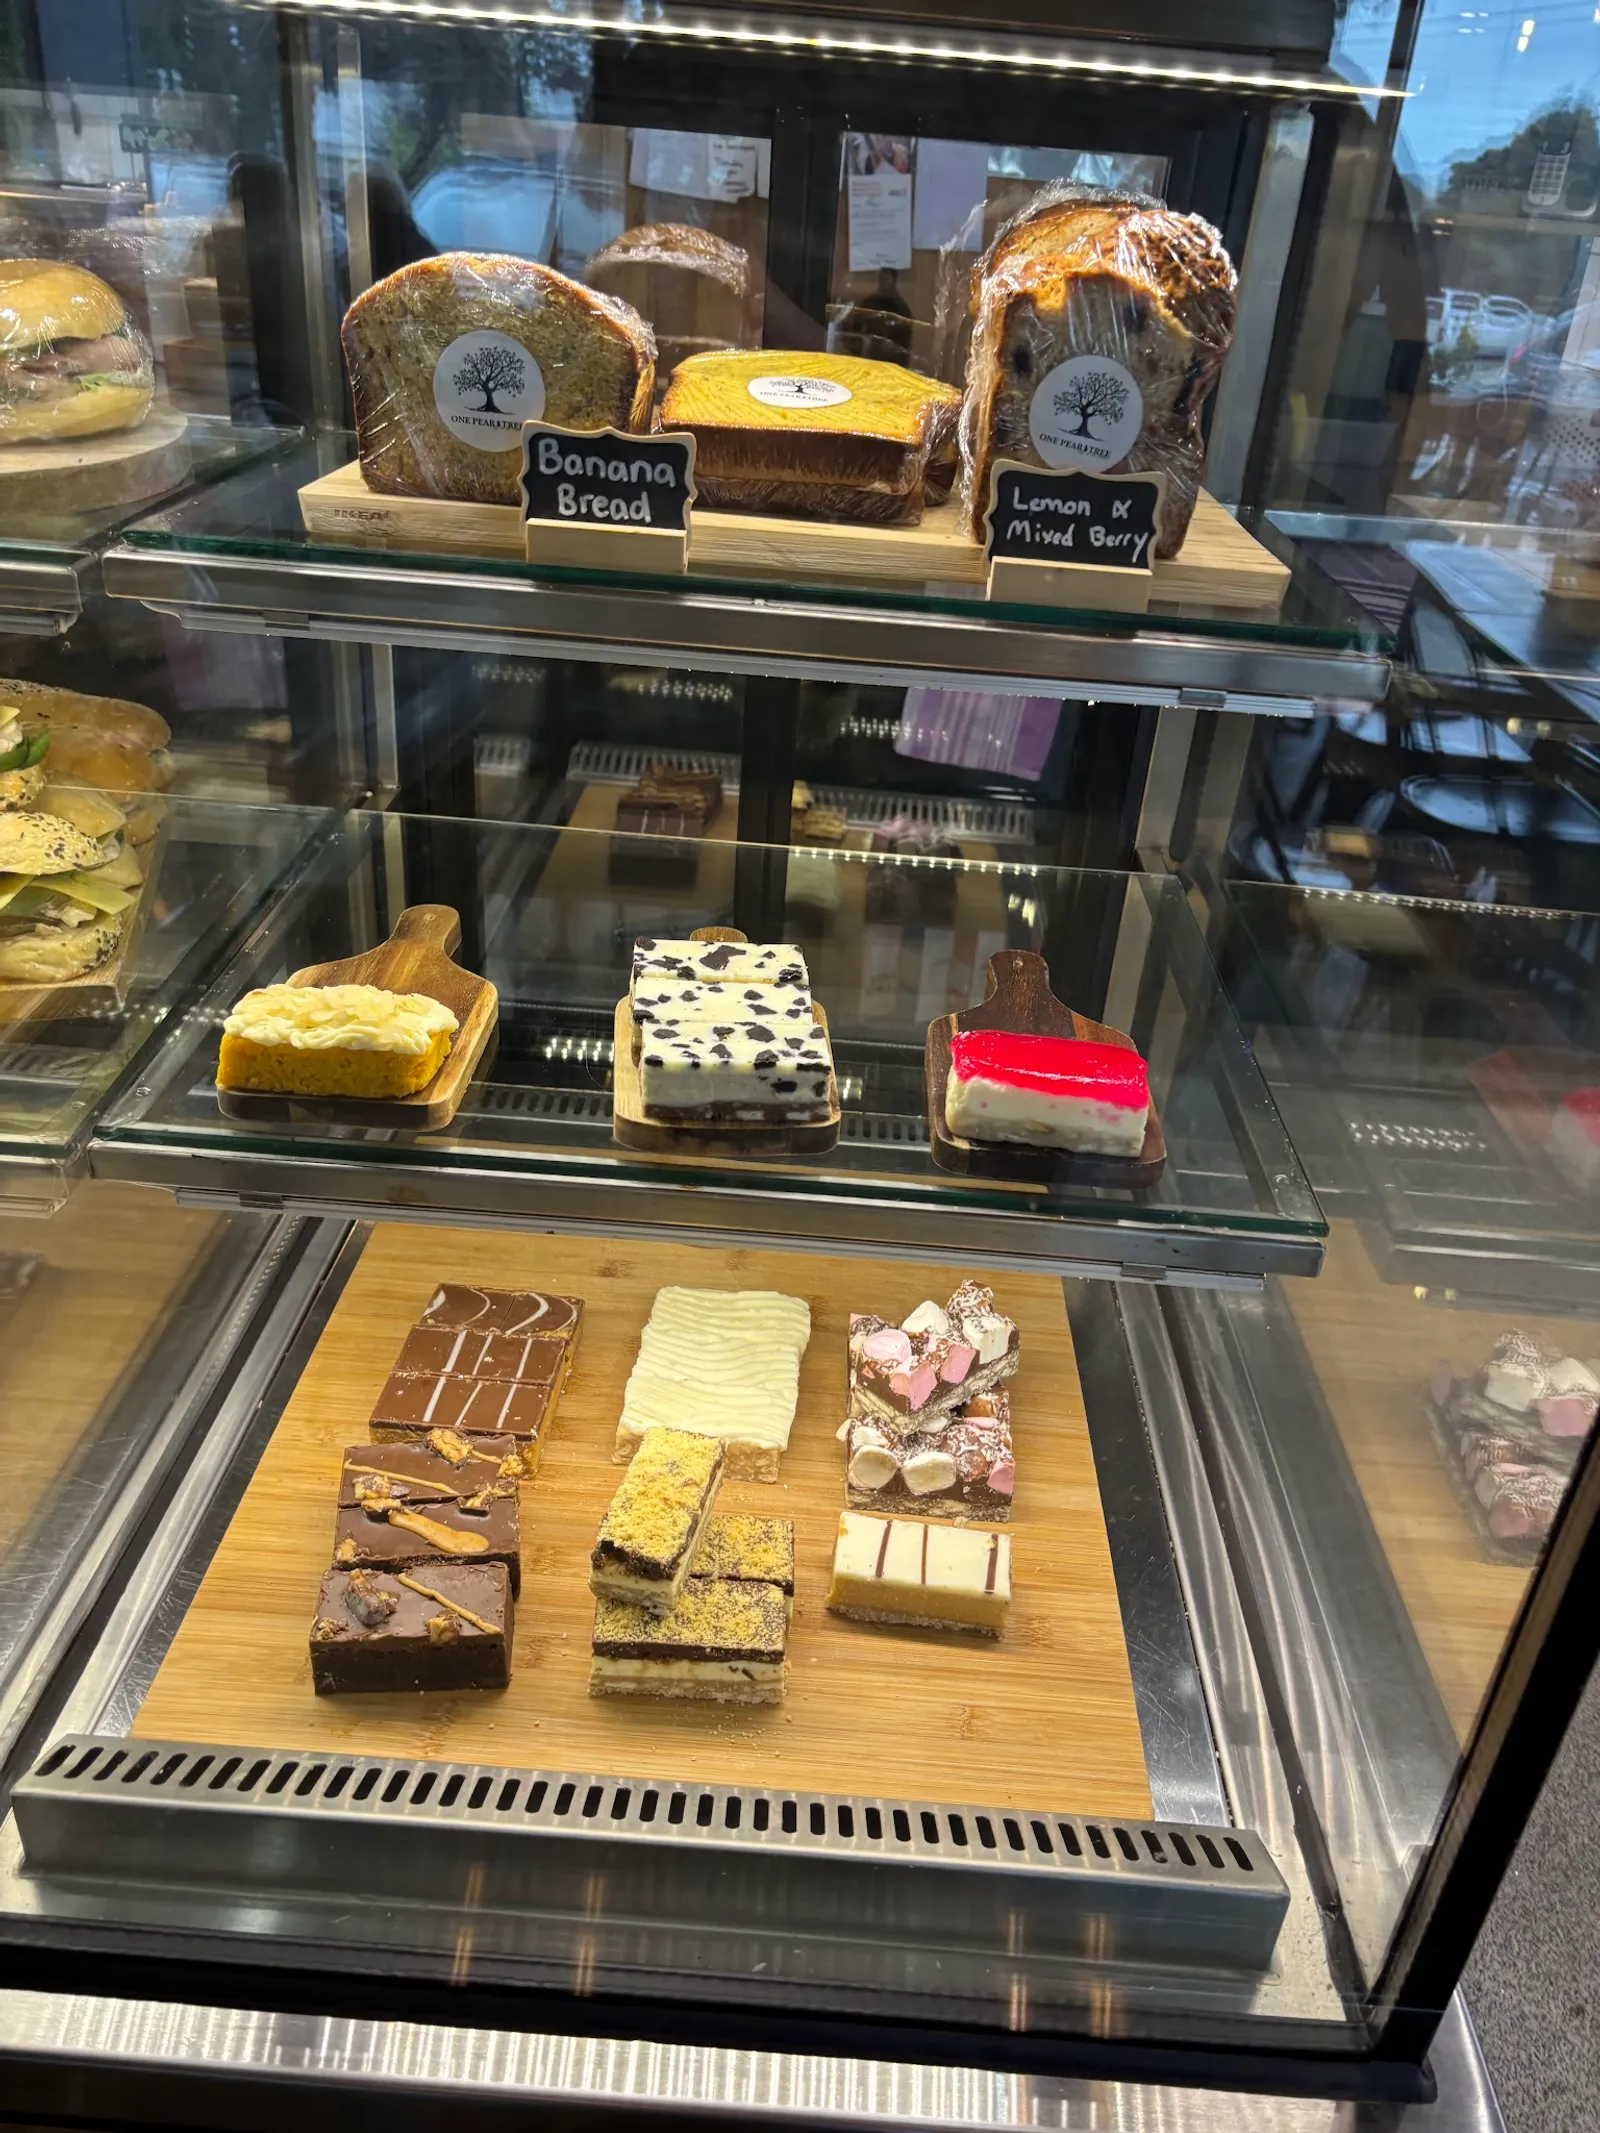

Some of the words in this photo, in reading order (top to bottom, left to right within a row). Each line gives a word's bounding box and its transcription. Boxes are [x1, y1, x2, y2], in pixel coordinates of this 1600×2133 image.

[450, 415, 471, 425] ONE
[472, 417, 496, 428] PEAR
[538, 437, 676, 488] Banana
[1039, 433, 1060, 445] ONE
[1060, 438, 1083, 451] PEAR
[1089, 445, 1112, 459] TREE
[557, 483, 651, 523] Bread
[1013, 486, 1091, 516] Lemon
[1006, 519, 1075, 547] Mixed
[1089, 525, 1149, 563] Berry
